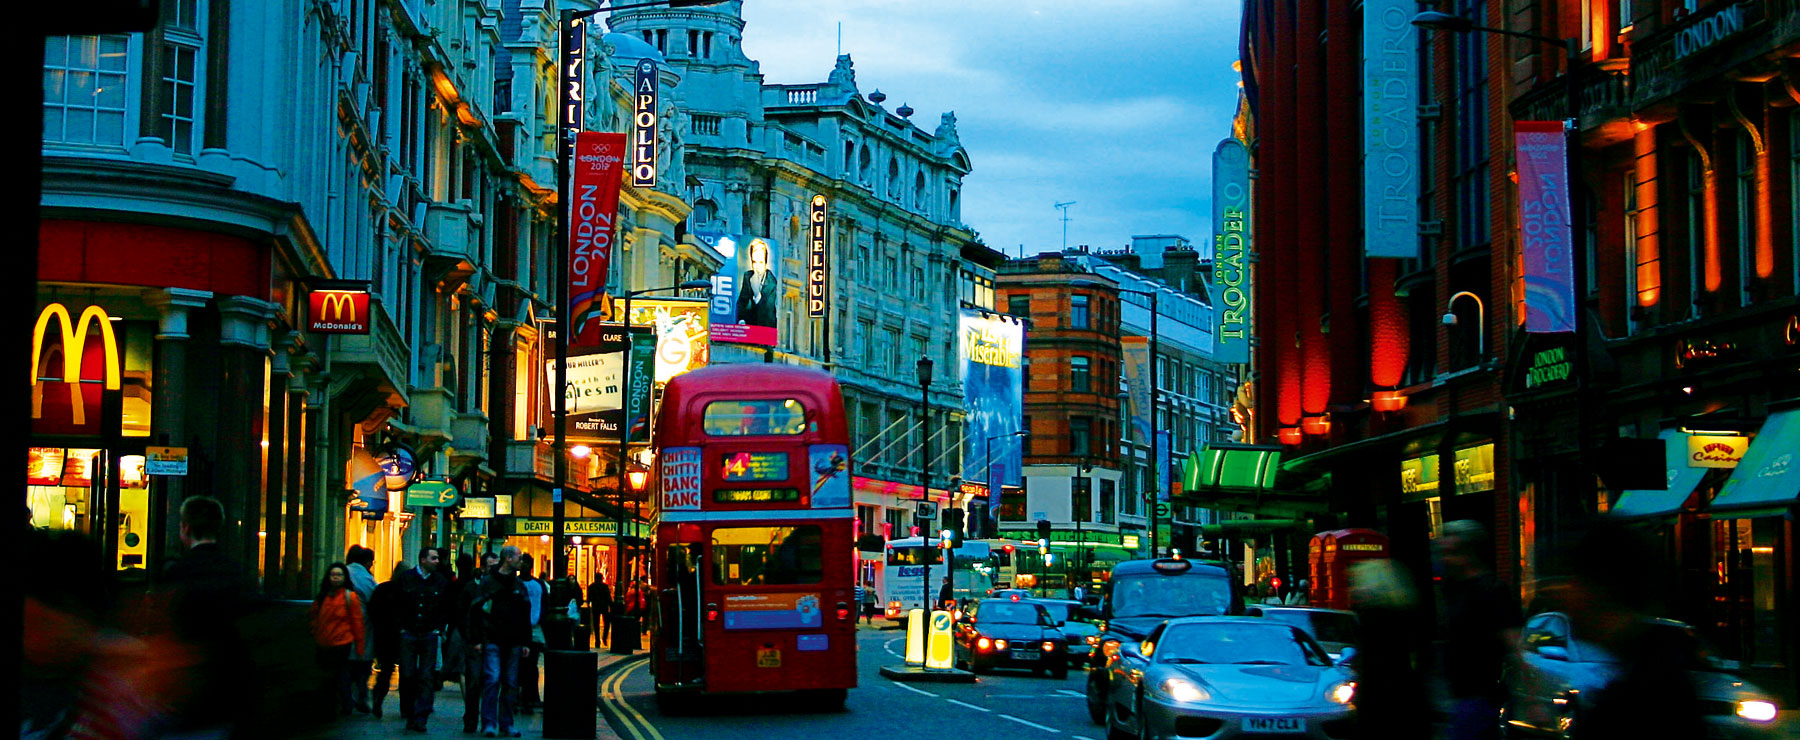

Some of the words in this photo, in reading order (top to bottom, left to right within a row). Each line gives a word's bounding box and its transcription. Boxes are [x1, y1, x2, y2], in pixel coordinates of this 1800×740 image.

[1674, 3, 1738, 60] LONDON
[636, 78, 655, 181] APOLLO
[1376, 6, 1413, 231] TROCADERO
[572, 184, 598, 287] LONDON
[591, 212, 612, 260] 2012
[811, 210, 825, 312] GIELGUD
[1215, 234, 1223, 285] LONDON
[1219, 182, 1247, 344] TROCADERO
[313, 322, 363, 330] McDonald's
[602, 333, 623, 342] CLARE
[577, 358, 605, 369] MILLER'S
[1534, 346, 1564, 368] LONDON
[1528, 361, 1570, 386] TROCADERO
[631, 360, 645, 413] LONDON
[575, 421, 599, 430] ROBERT
[600, 423, 618, 431] FALLS
[663, 450, 698, 463] CHITTY
[663, 462, 698, 477] CHITTY
[663, 476, 699, 492] BANG
[664, 491, 699, 508] BANG
[524, 521, 550, 531] DEATH
[565, 522, 571, 531] A
[573, 522, 617, 532] SALESMAN
[1276, 718, 1299, 730] CLA
